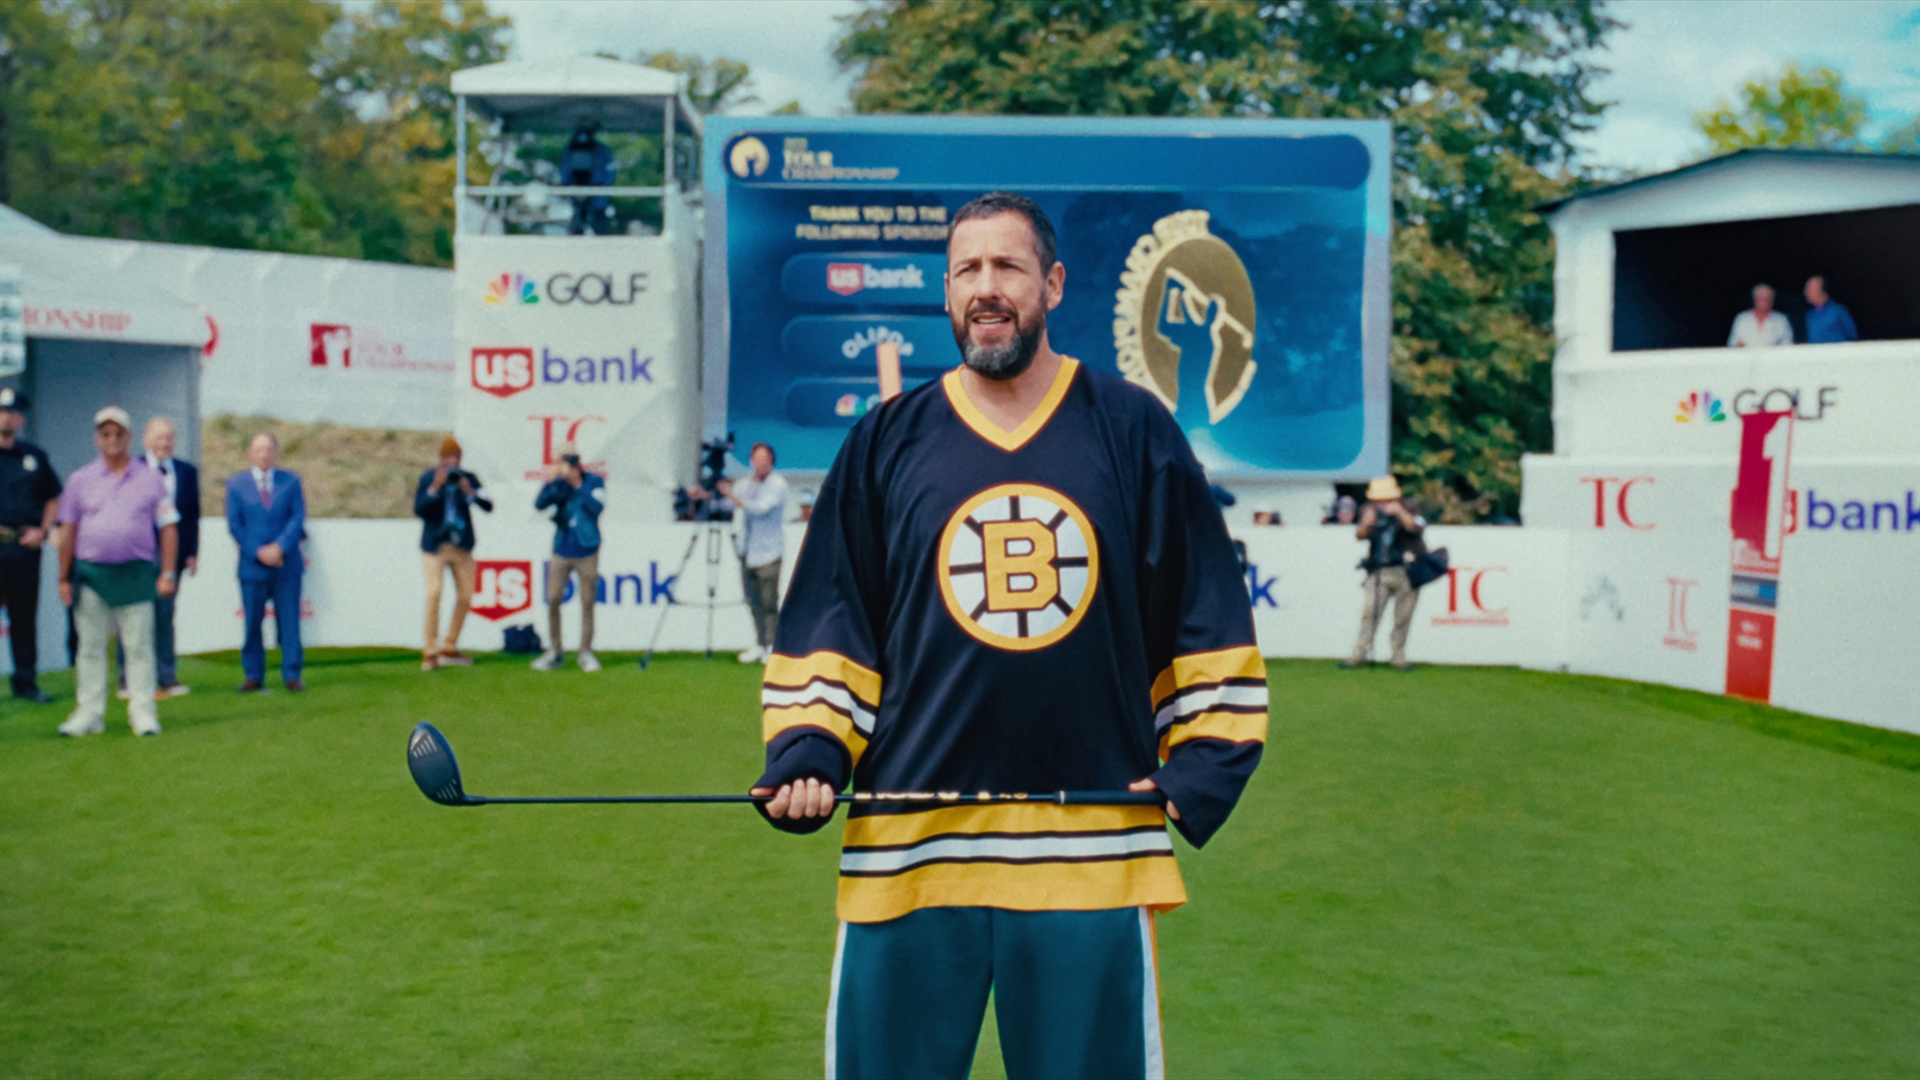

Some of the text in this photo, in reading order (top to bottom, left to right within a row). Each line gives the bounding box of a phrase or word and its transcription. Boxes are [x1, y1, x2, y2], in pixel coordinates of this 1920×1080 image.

[809, 205, 947, 222] THANK YOU TO THE
[796, 224, 880, 240] FOLLOWING
[546, 273, 648, 305] GOLF
[864, 264, 924, 288] bank
[543, 347, 653, 383] bank
[1734, 387, 1838, 420] GOLF
[1580, 476, 1656, 531] TC
[980, 517, 1061, 613] B
